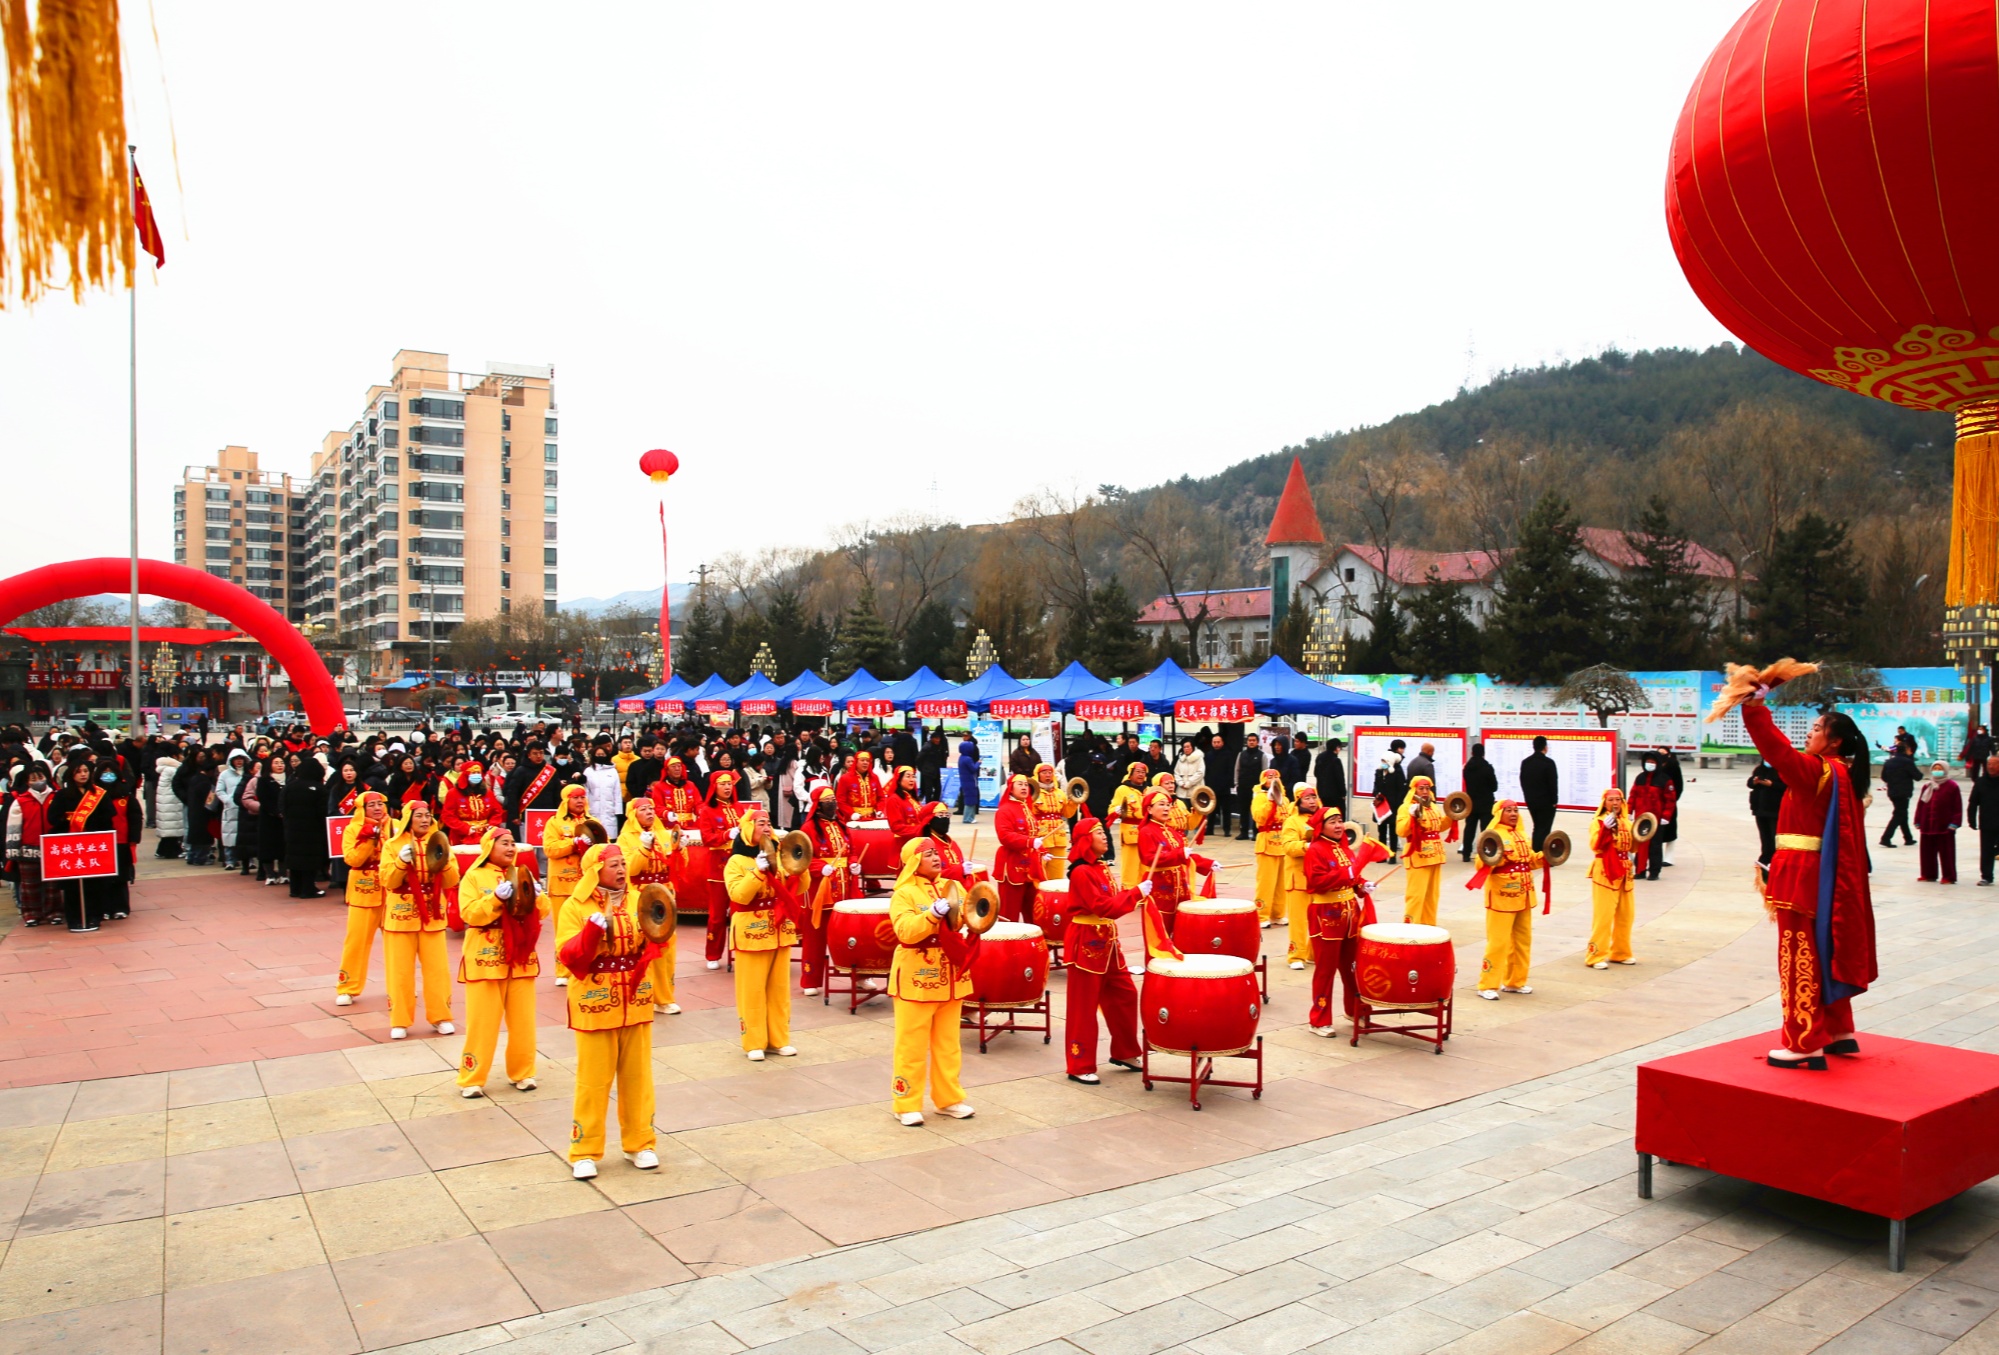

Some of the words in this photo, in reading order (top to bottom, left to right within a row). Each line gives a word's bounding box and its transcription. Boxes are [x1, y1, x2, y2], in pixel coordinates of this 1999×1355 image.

[917, 703, 965, 715] 退役军人招聘专区
[993, 703, 1046, 715] 吕梁山护工招聘专区
[1078, 703, 1140, 717] 高校毕业生招聘专区
[1178, 703, 1250, 718] 农民工招聘专区
[50, 841, 109, 856] 高校毕业生
[59, 857, 101, 870] 代表队
